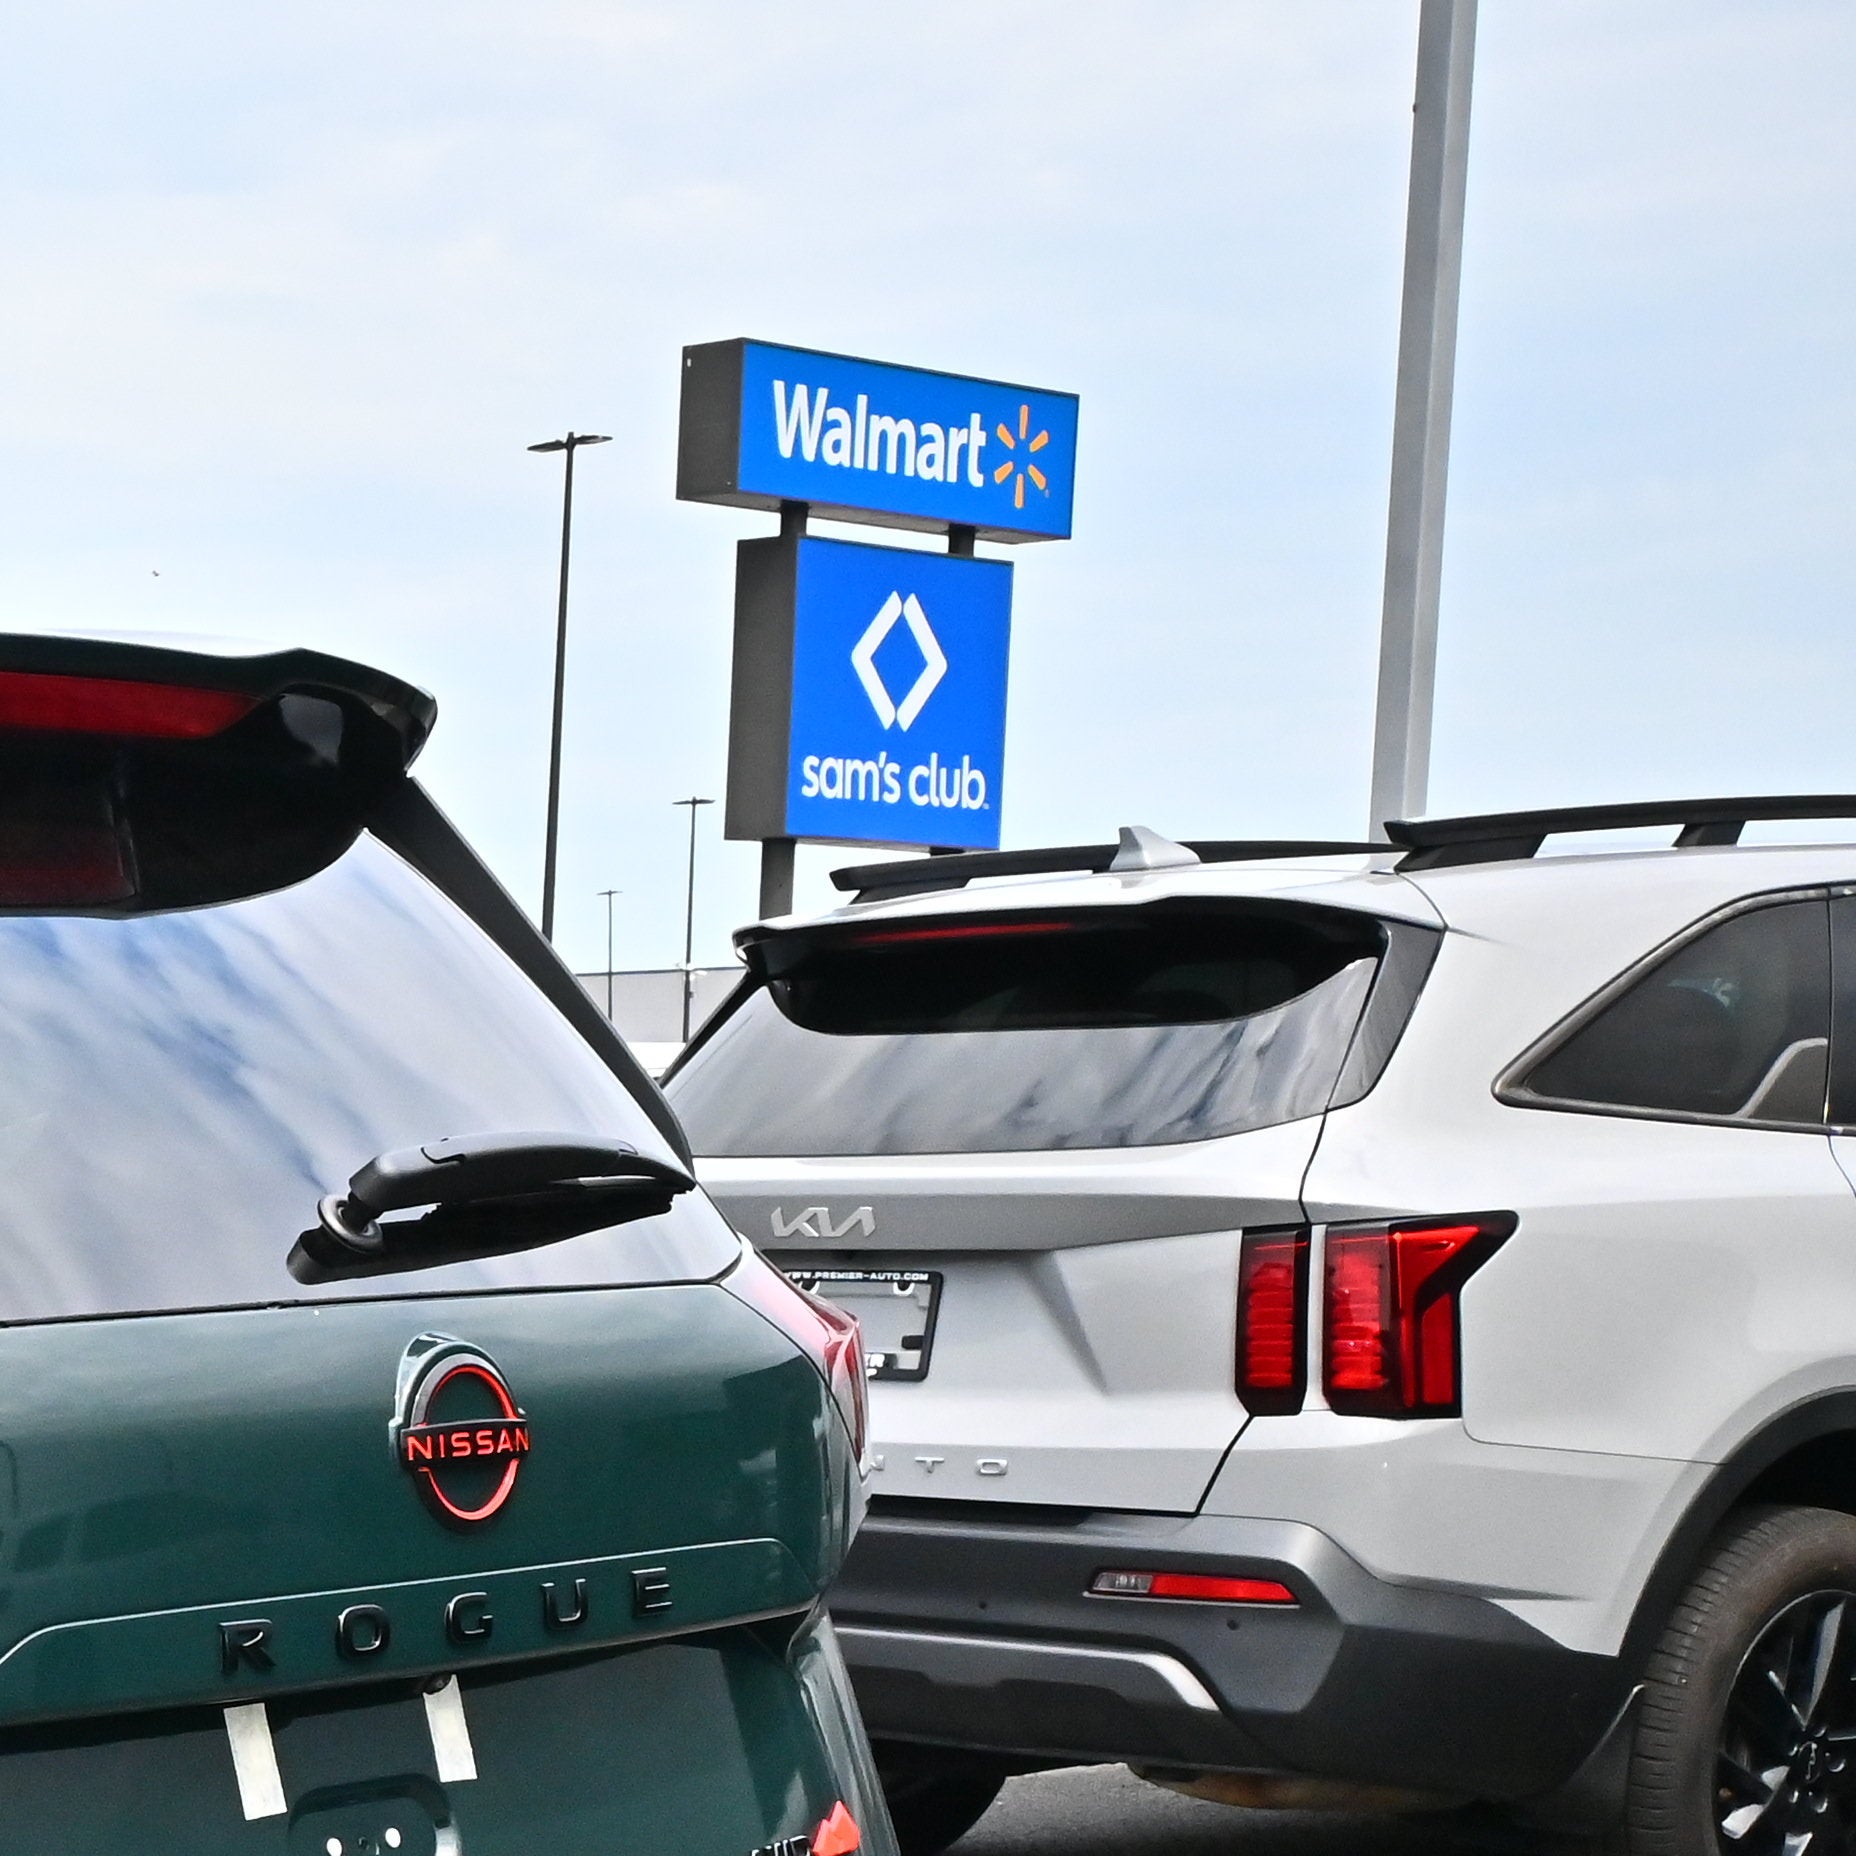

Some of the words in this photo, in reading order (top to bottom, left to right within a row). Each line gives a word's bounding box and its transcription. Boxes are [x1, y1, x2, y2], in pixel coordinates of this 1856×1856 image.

[773, 380, 987, 488] Walmart
[801, 751, 901, 804] sam's
[908, 752, 988, 810] club
[771, 1206, 876, 1238] KIA
[406, 1427, 530, 1461] NISSAN
[219, 1567, 673, 1676] ROGUE
